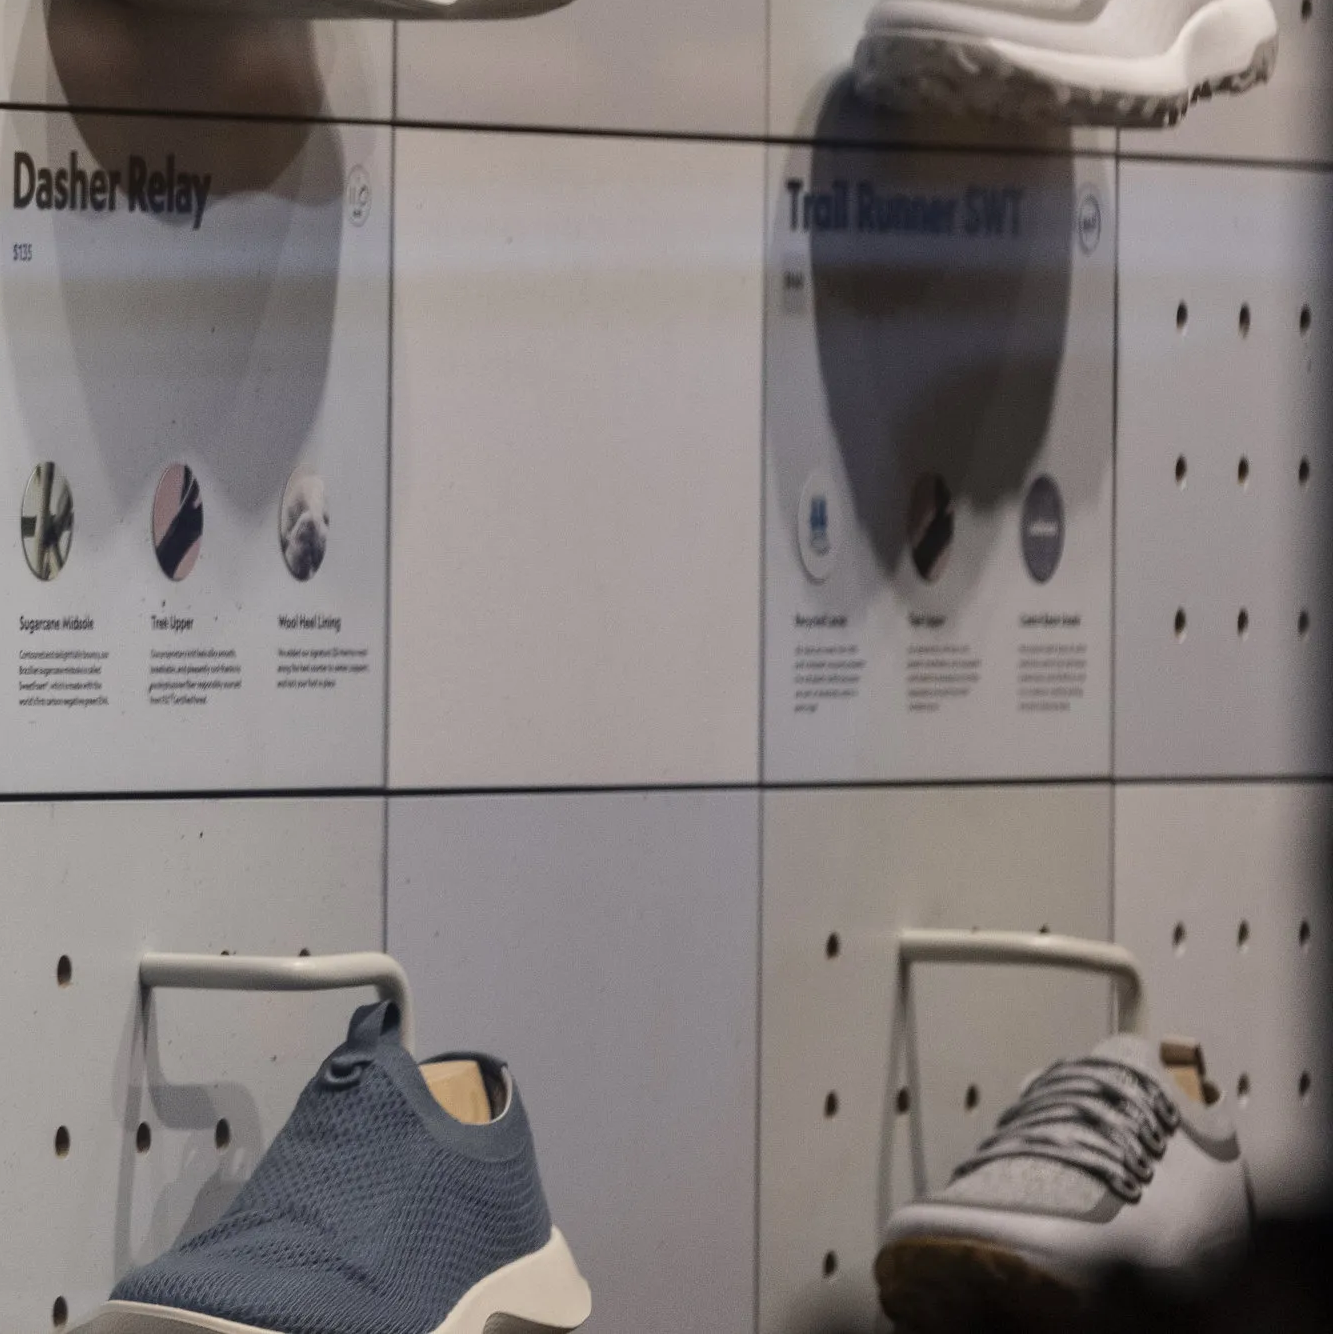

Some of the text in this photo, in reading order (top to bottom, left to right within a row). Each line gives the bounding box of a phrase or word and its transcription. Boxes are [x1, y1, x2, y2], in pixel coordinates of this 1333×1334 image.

[12, 150, 212, 231] Dasher Relay
[784, 177, 850, 232] Trail
[856, 179, 958, 236] Runner
[19, 614, 94, 634] Sugarcane Midsole
[151, 615, 194, 633] Tree Upper
